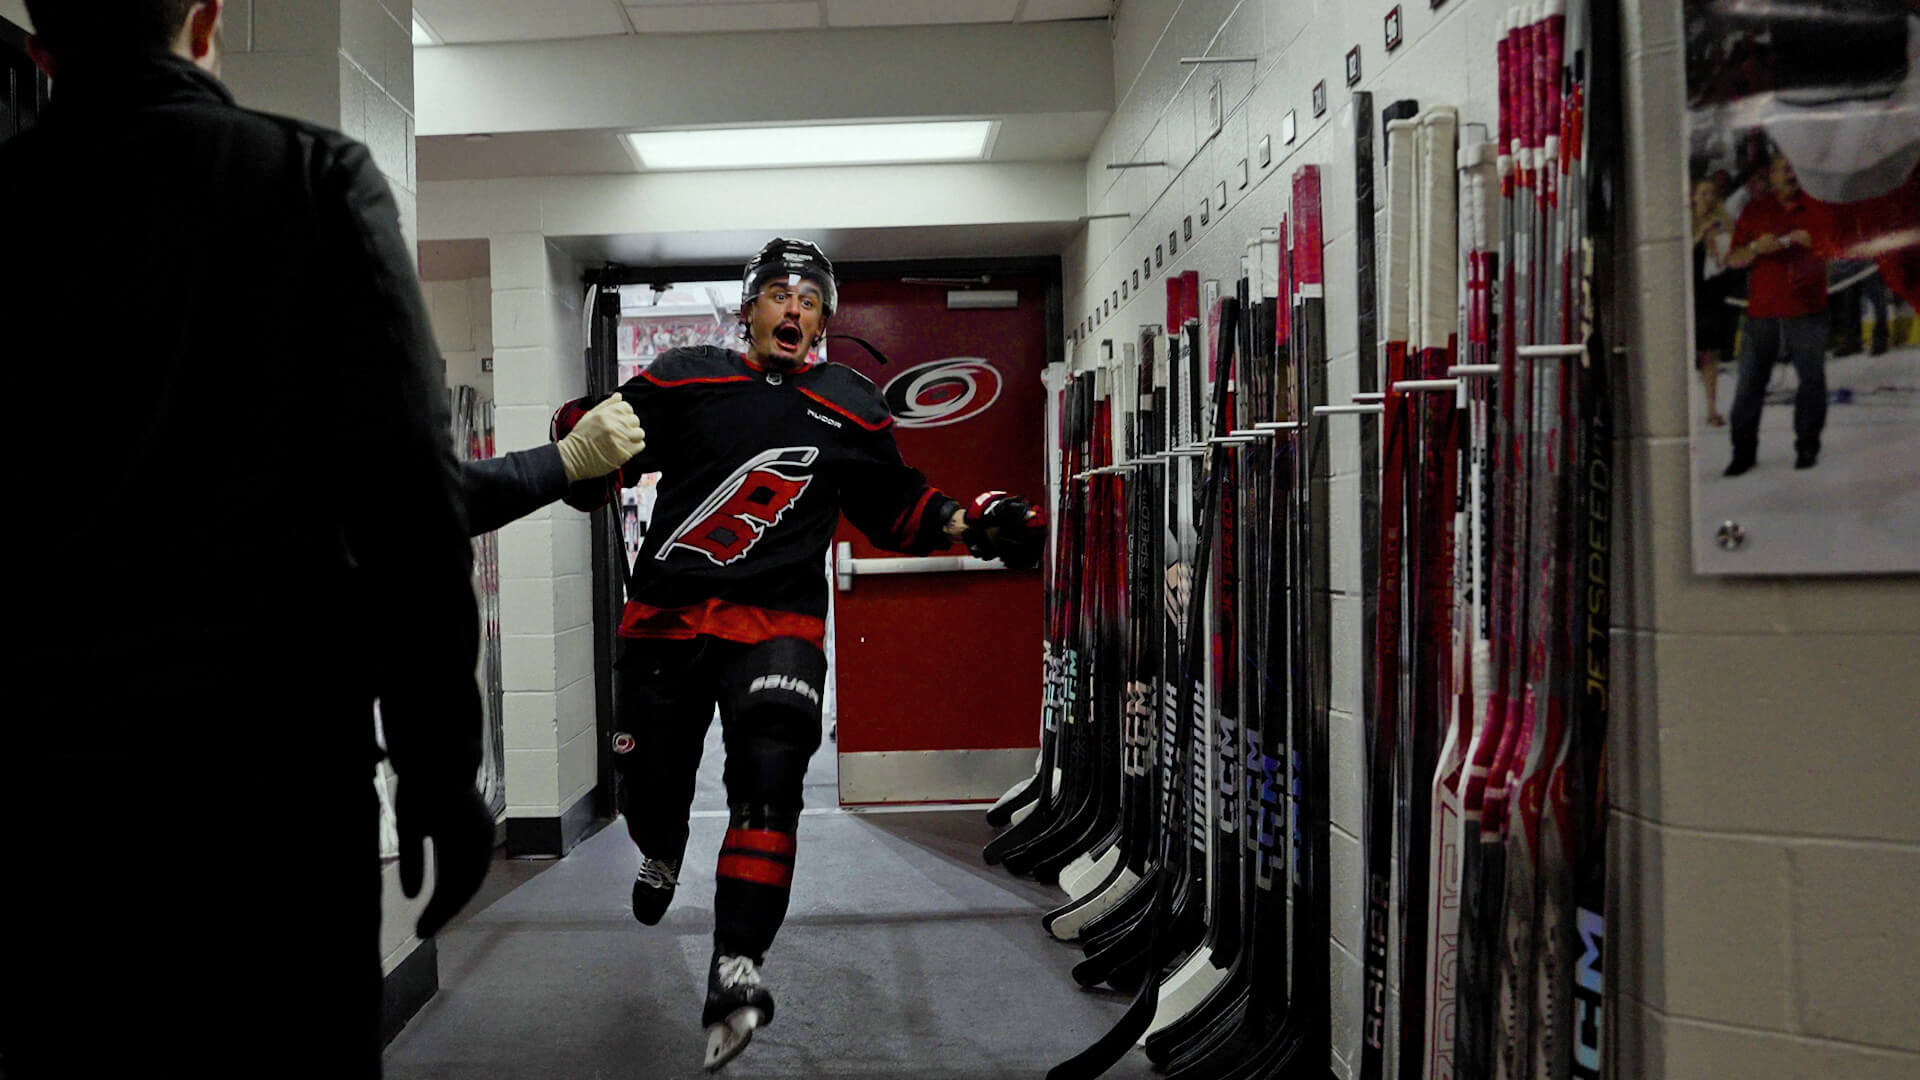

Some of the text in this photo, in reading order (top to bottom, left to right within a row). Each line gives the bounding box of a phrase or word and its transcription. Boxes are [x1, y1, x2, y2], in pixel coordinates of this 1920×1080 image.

[806, 408, 842, 429] NUCOR
[1587, 458, 1610, 711] JETSPEED
[1193, 679, 1206, 854] WARRIOR
[1217, 716, 1239, 834] CCM
[1257, 755, 1277, 892] CCM
[1573, 905, 1605, 1080] CM
